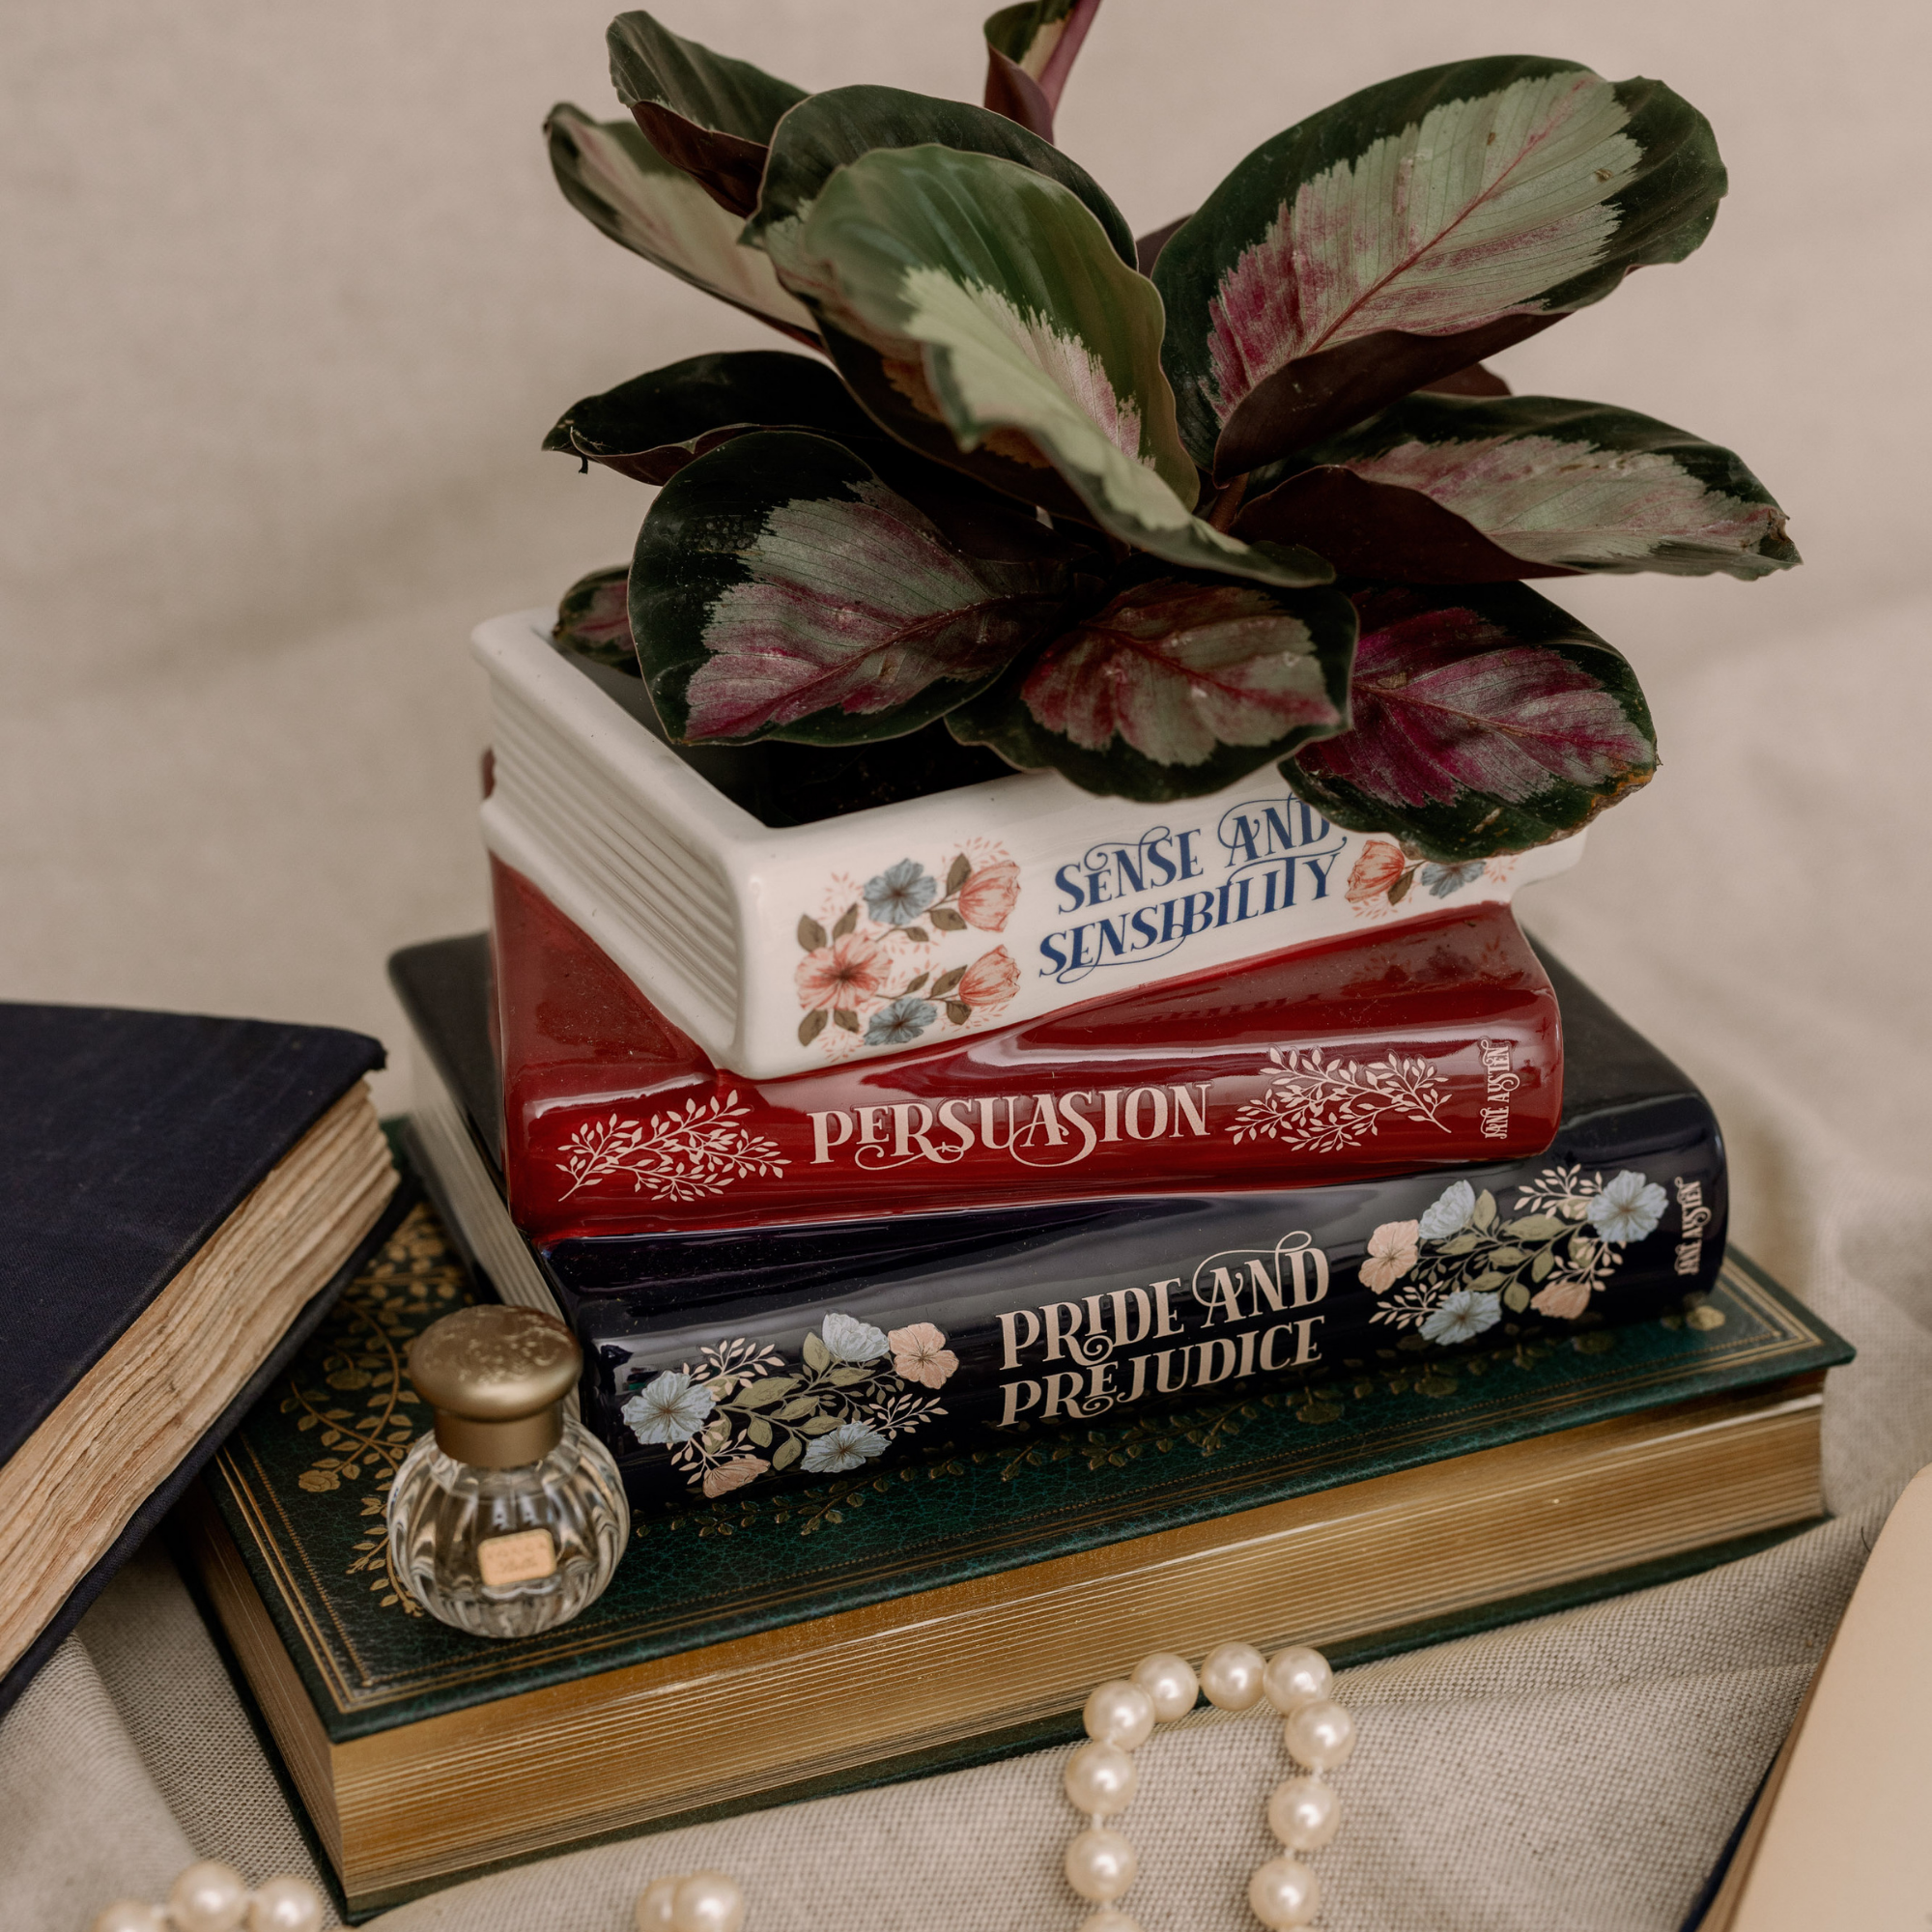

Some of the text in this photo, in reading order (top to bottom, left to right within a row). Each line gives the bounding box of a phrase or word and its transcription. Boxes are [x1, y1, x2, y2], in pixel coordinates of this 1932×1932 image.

[1055, 791, 1331, 915] SENSE AND
[1038, 837, 1348, 984] SENSIBILITY
[807, 1081, 1214, 1170] PERSUASION
[1480, 1039, 1520, 1139] JANE AUSTEN
[1674, 1177, 1712, 1276] JANE AUSTEN
[995, 1230, 1329, 1371] PRIDE AND
[996, 1315, 1326, 1427] PREJUDICE
